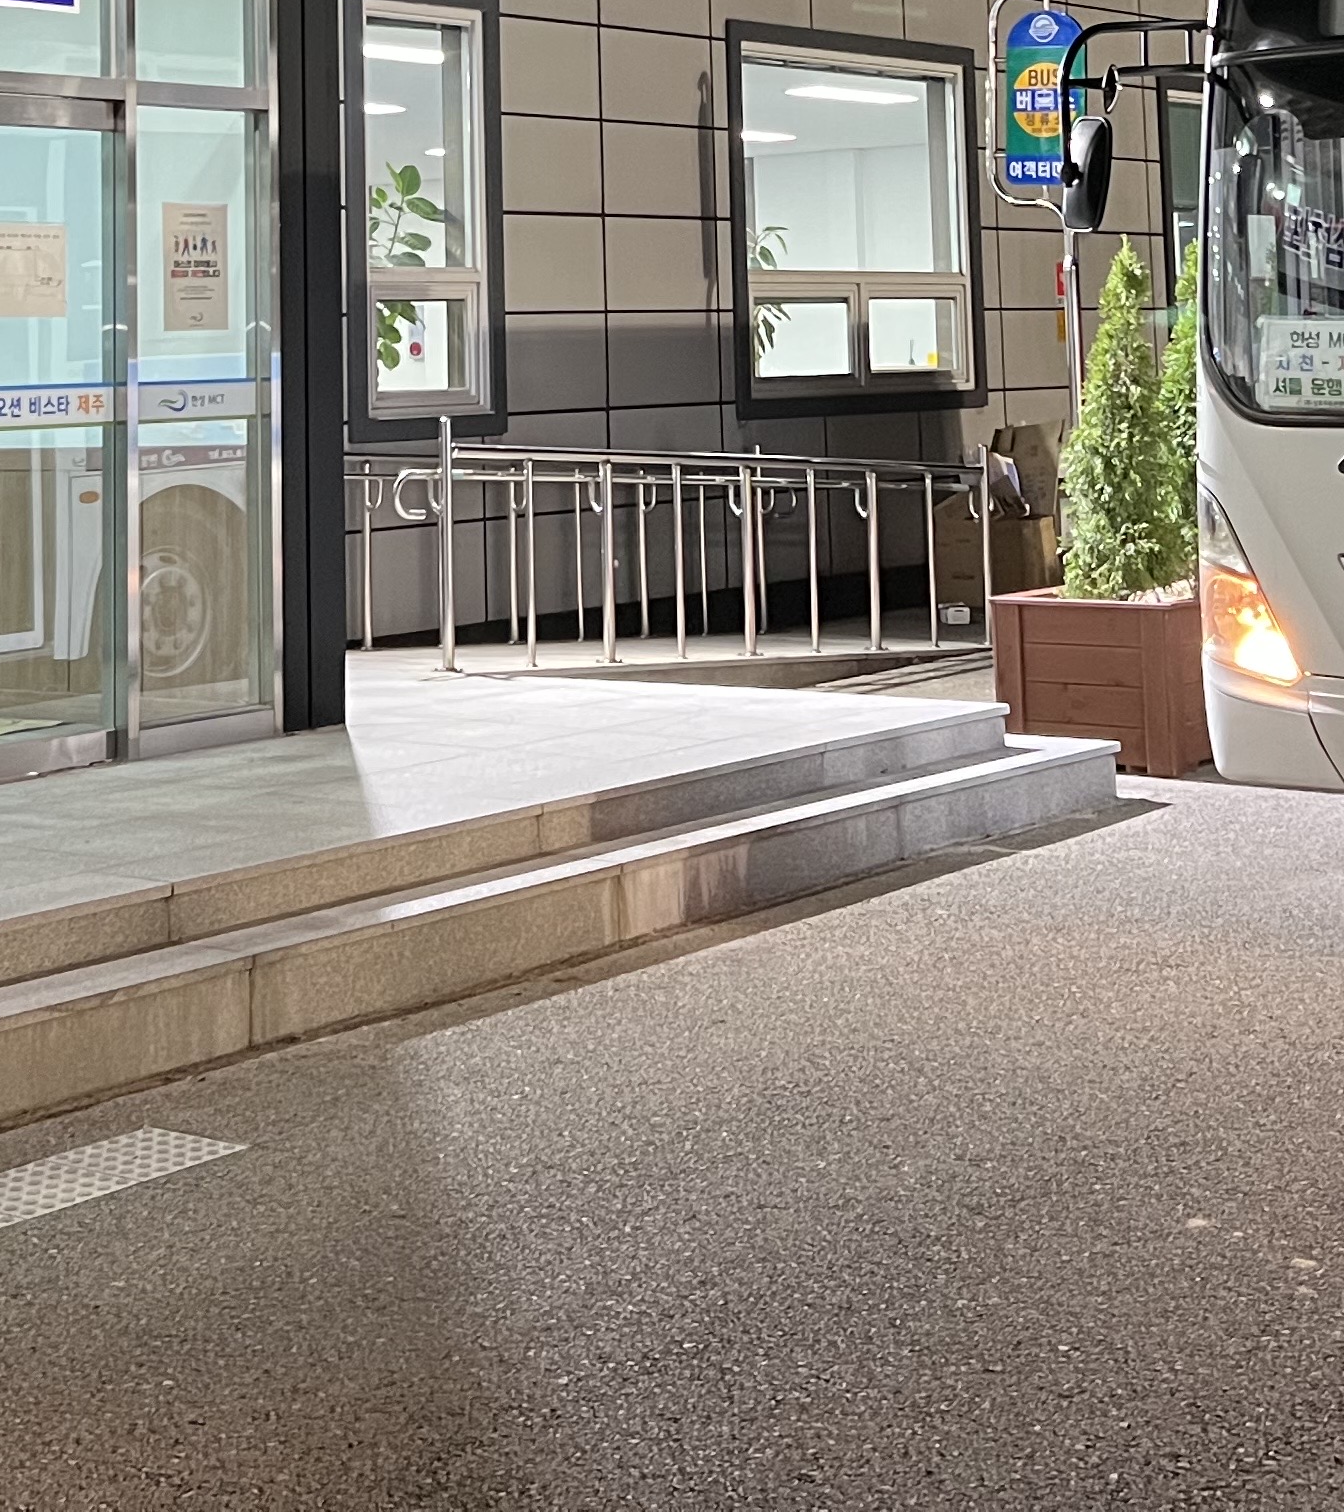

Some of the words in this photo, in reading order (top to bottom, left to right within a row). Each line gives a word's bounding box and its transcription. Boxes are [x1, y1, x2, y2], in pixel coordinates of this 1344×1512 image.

[1009, 161, 1063, 178] 여객터미
[1289, 330, 1321, 349] 현성
[1310, 377, 1342, 396] 운행
[28, 394, 70, 416] 비스타
[76, 393, 105, 414] 제주
